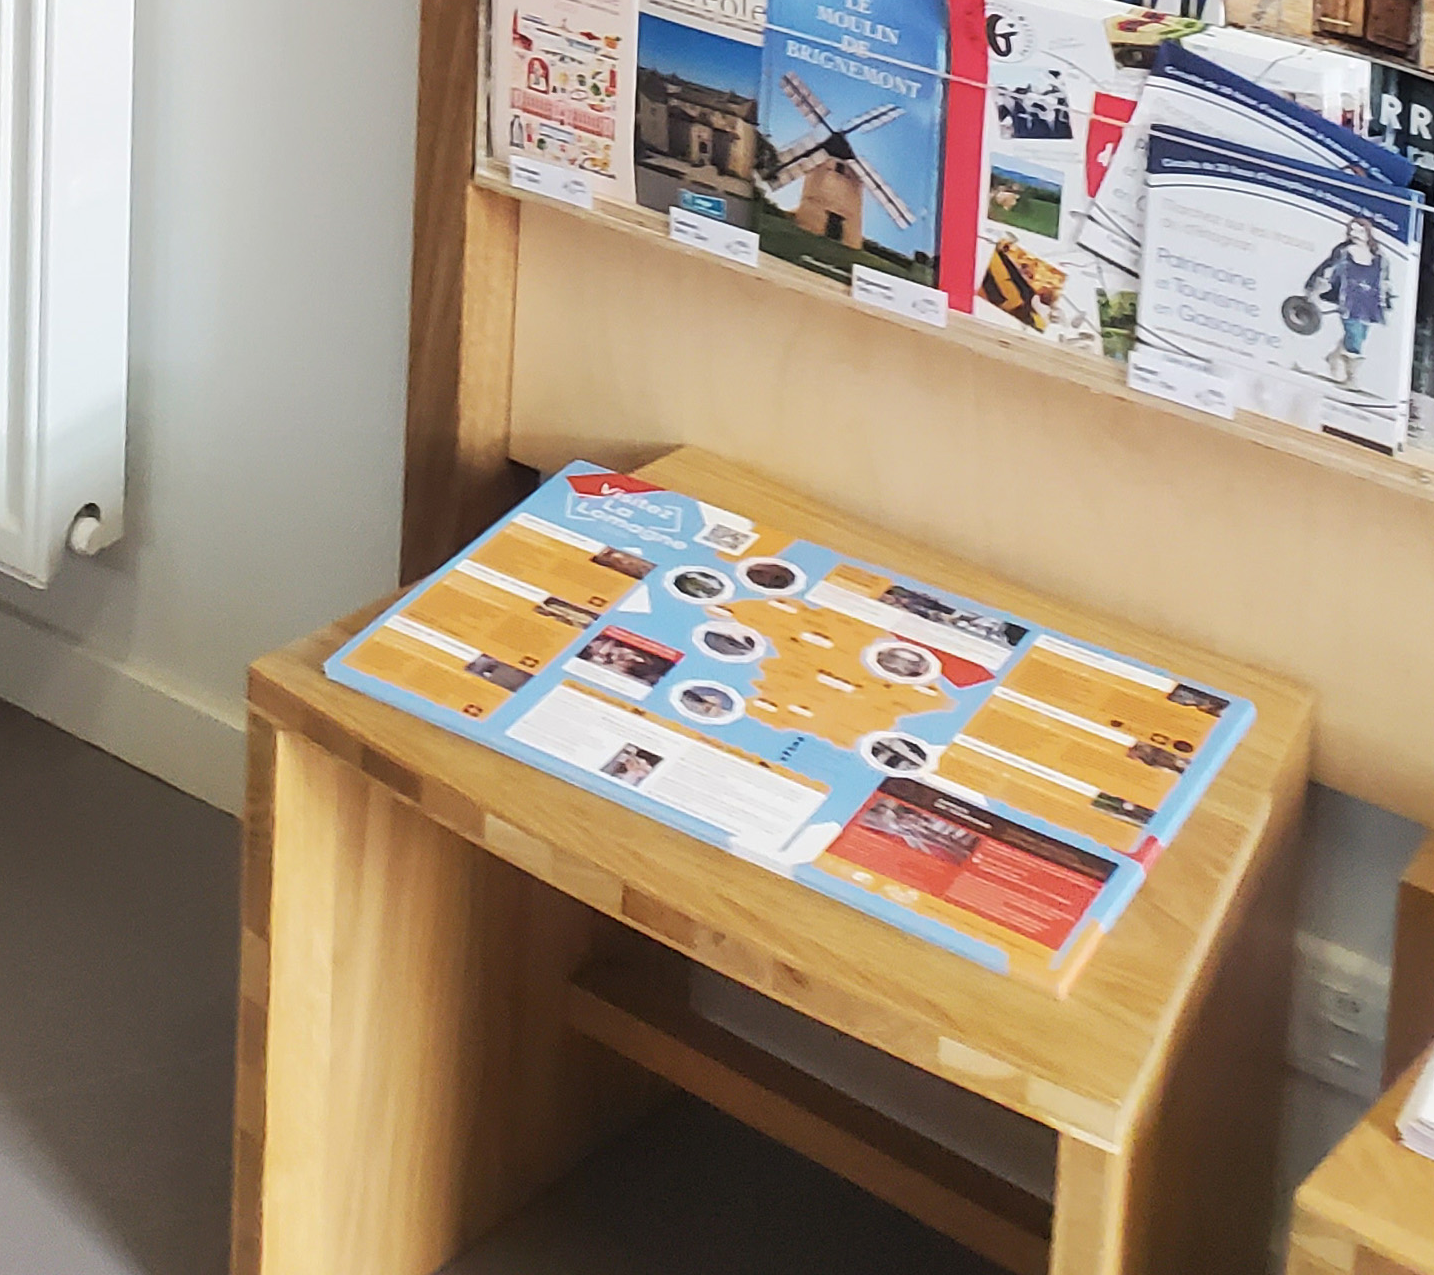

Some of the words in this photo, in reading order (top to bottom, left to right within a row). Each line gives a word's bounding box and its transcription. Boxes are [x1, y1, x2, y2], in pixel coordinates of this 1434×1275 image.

[815, 5, 900, 45] MOULIN
[786, 39, 922, 100] BRIGNEMONT
[1172, 276, 1260, 318] Tourisme
[1178, 304, 1282, 349] Gascogne
[576, 501, 688, 550] Lomagne
